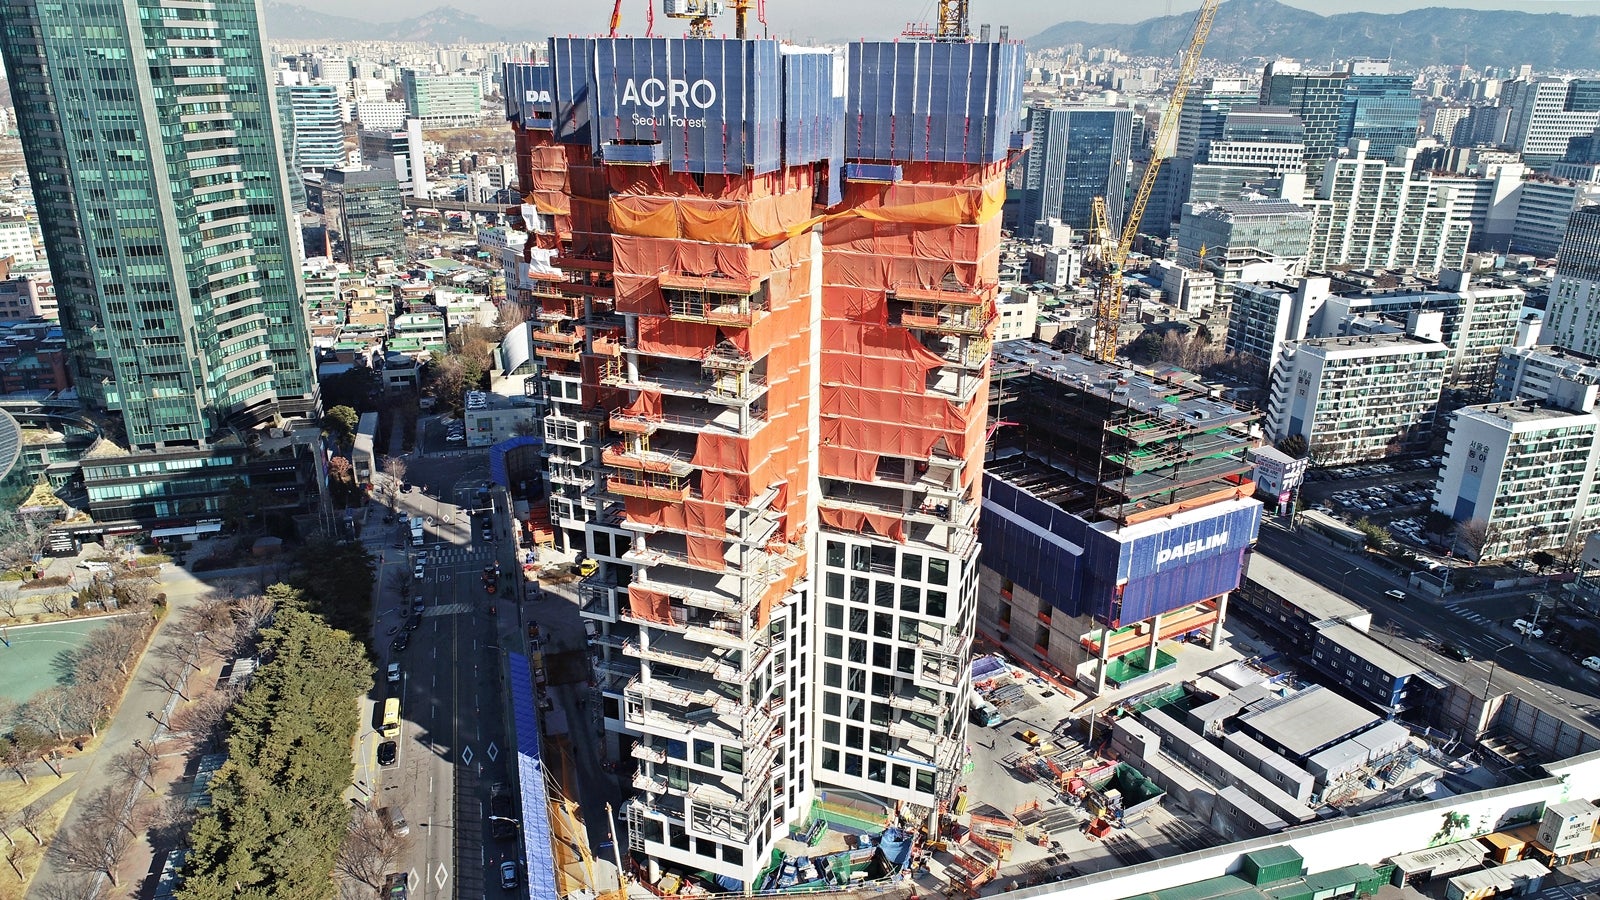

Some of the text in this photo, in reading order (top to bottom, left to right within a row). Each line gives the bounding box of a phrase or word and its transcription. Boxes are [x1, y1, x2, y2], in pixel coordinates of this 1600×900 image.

[622, 78, 716, 109] ACRO
[632, 113, 707, 128] Seoul Forest
[1470, 465, 1478, 473] 13
[1156, 531, 1228, 564] DAELIM
